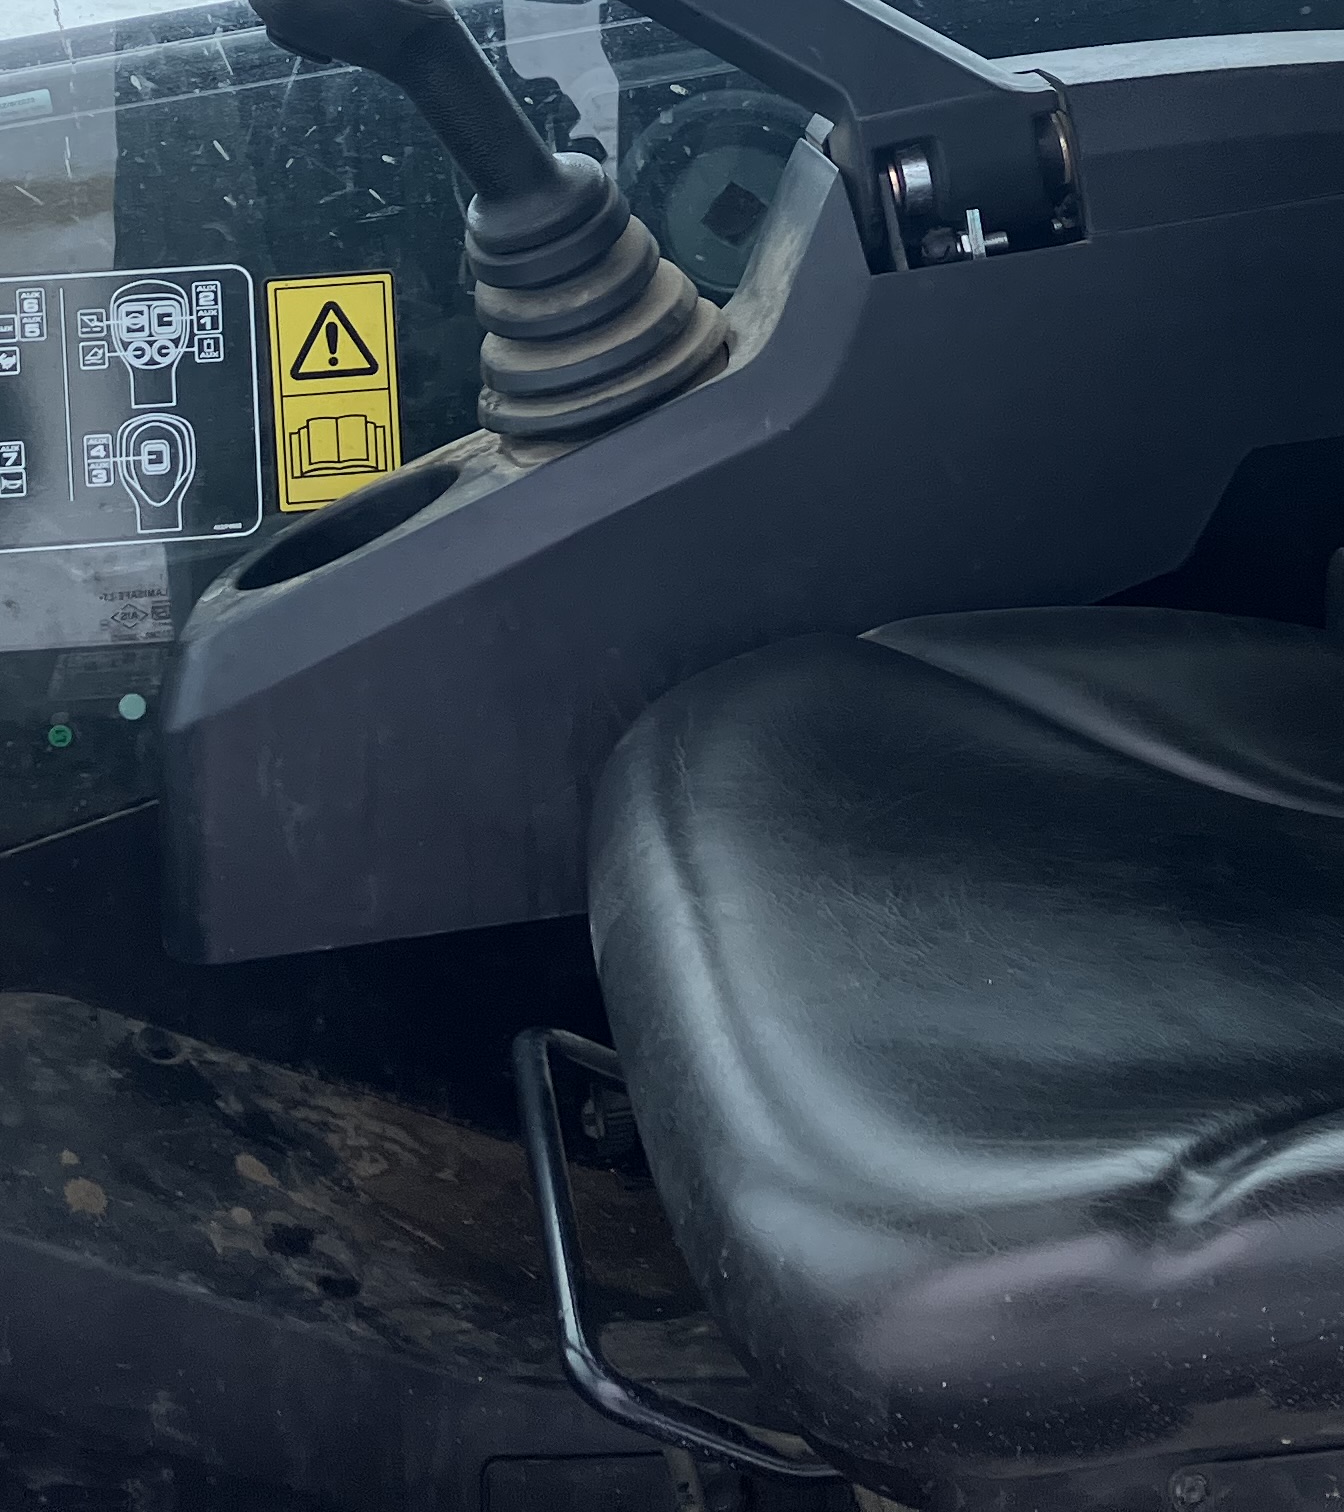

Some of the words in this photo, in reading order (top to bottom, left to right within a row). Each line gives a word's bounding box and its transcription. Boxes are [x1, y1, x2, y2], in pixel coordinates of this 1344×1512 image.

[198, 292, 215, 305] 2
[23, 299, 39, 313] 6
[199, 317, 212, 330] 1
[24, 324, 41, 337] 5
[90, 445, 106, 458] 4
[2, 452, 18, 466] 7
[92, 469, 107, 483] 3
